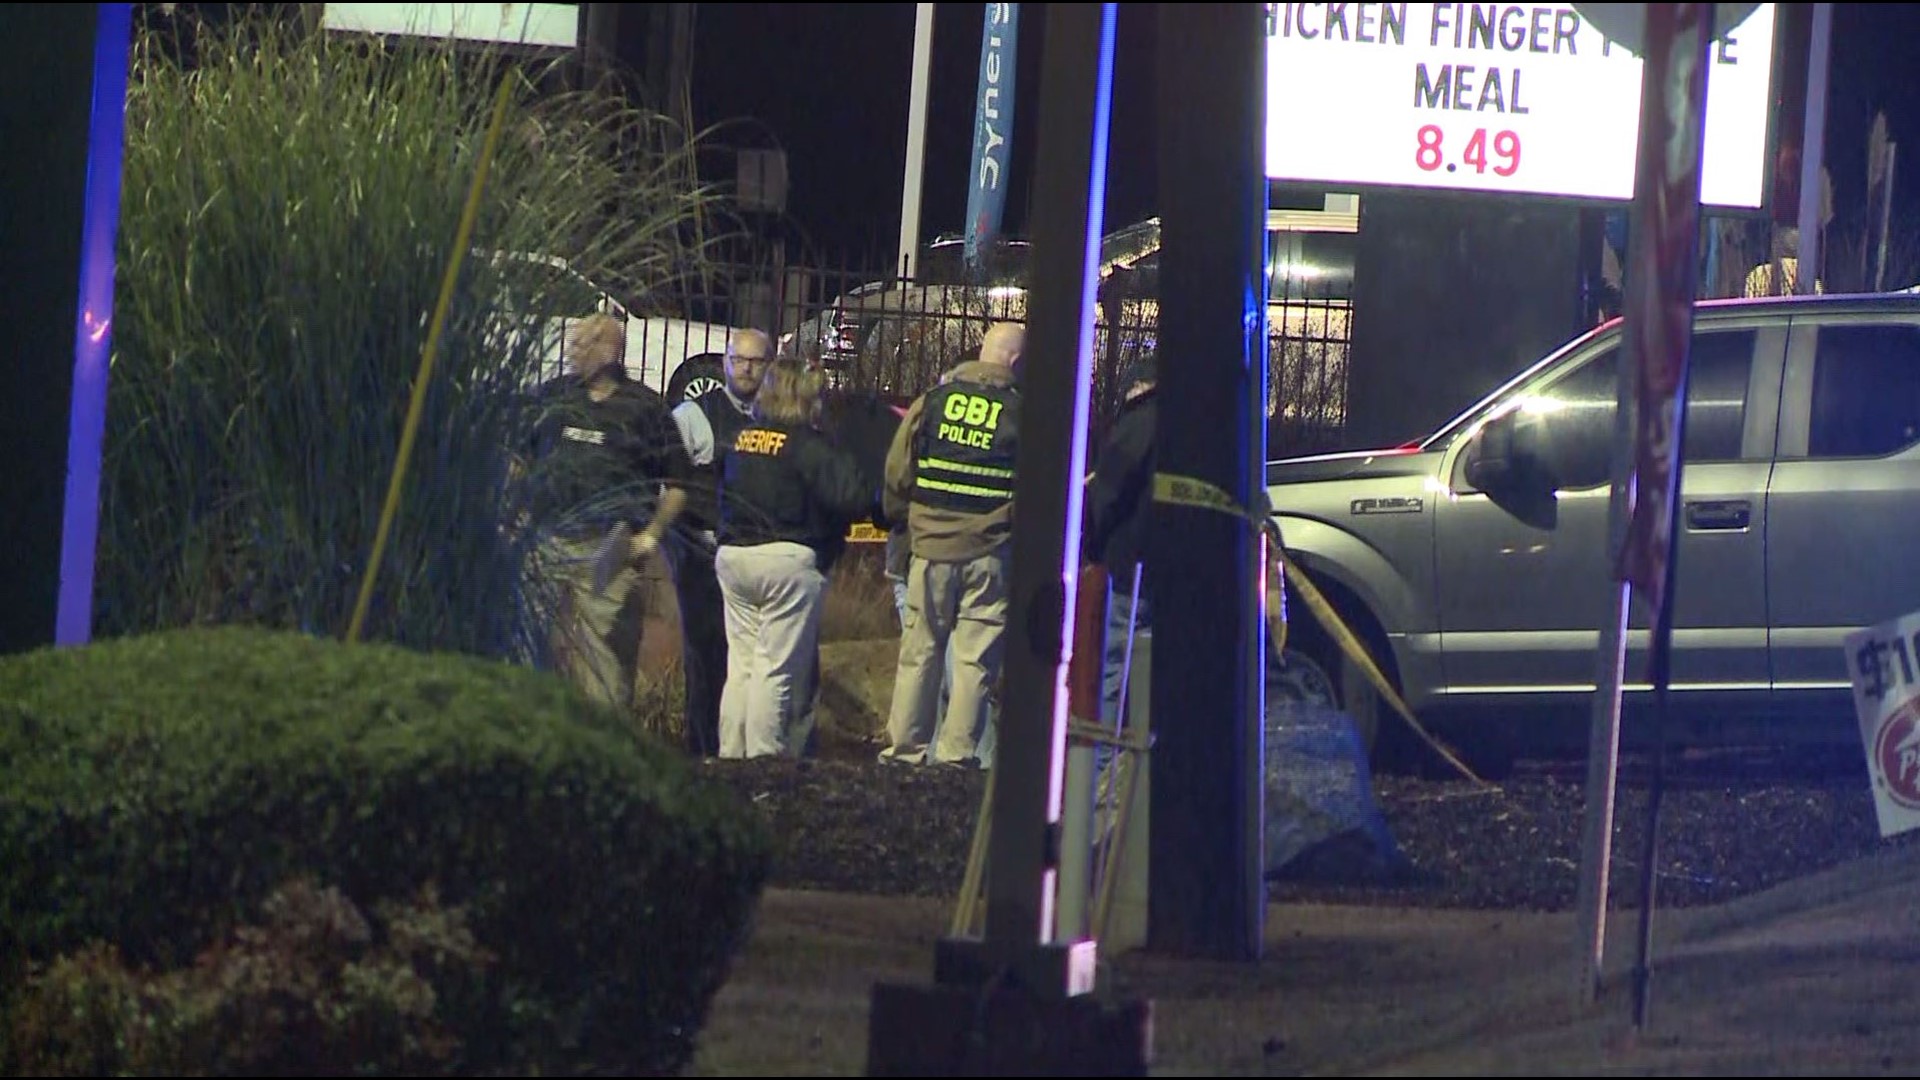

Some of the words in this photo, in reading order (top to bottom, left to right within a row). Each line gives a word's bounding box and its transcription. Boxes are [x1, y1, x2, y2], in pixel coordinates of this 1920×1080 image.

[1430, 3, 1580, 55] FINGER
[1414, 63, 1529, 114] MEAL
[1416, 124, 1521, 177] 8.49
[944, 393, 1003, 429] GBI
[734, 430, 787, 455] SHERIFF
[938, 423, 993, 450] POLICE
